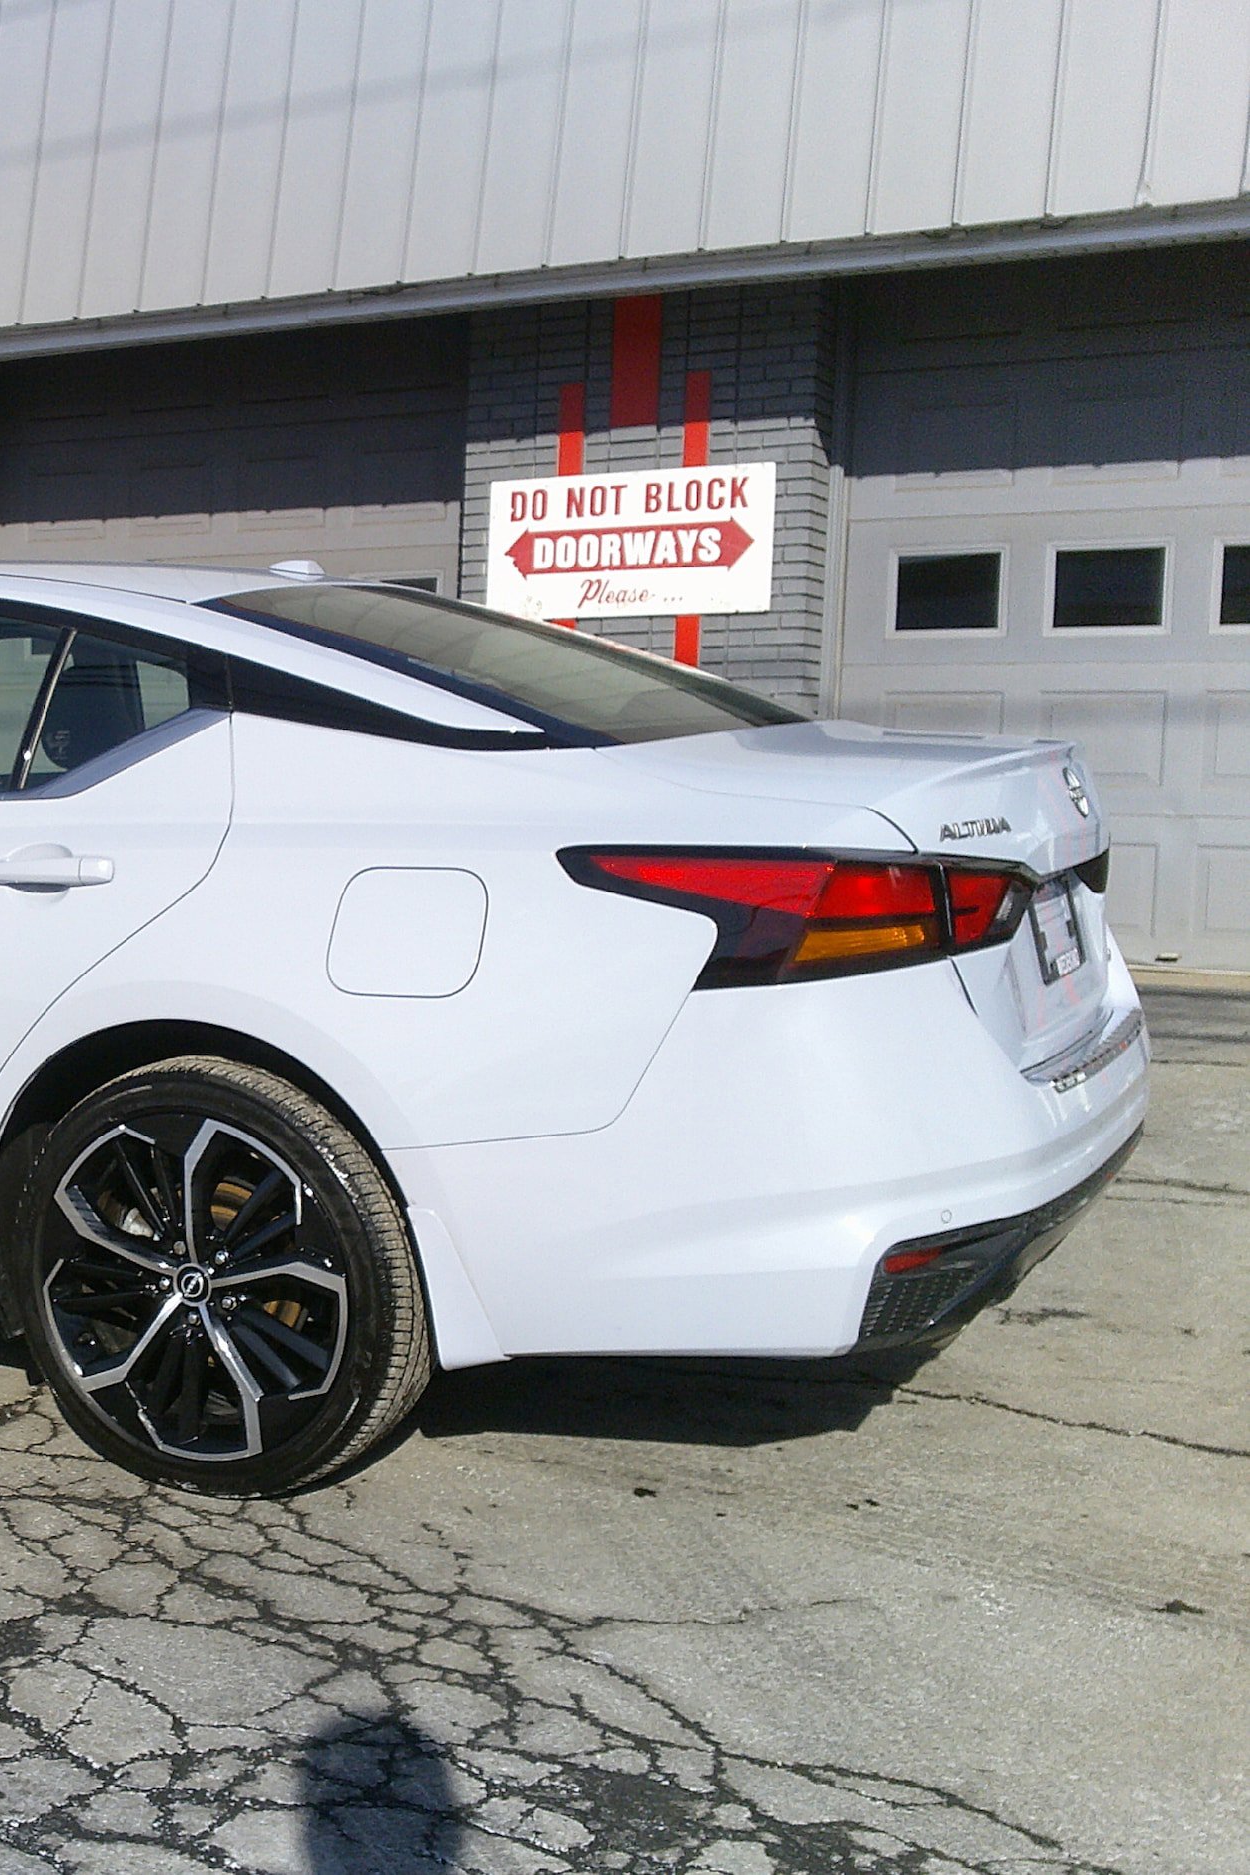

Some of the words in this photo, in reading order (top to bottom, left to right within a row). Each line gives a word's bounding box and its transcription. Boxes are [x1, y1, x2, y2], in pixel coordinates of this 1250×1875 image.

[510, 489, 548, 522] DO
[566, 485, 628, 519] NOT
[644, 476, 749, 514] BLOCK
[531, 527, 722, 571] DOORWAYS
[939, 816, 1012, 842] ALTIMA
